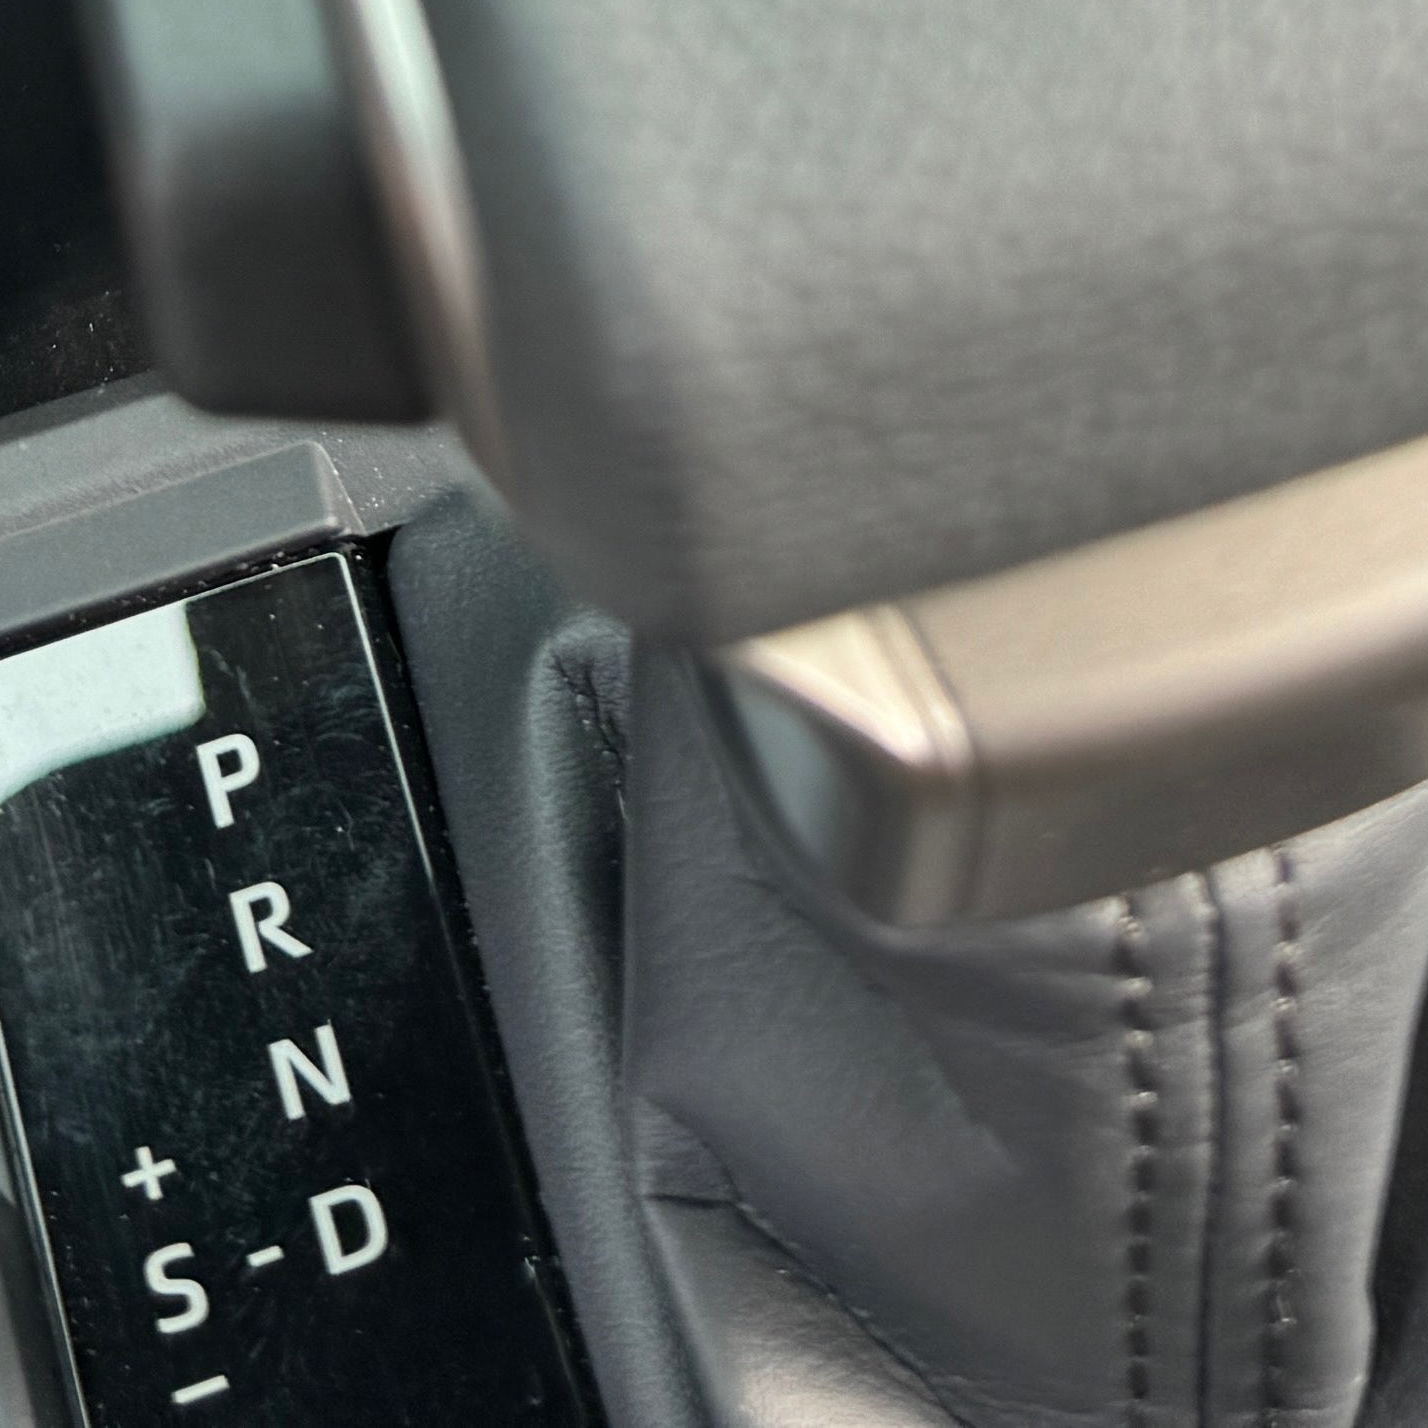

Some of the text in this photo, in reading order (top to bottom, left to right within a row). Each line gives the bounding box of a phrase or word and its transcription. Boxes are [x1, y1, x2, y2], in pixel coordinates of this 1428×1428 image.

[195, 733, 260, 828] P
[229, 881, 313, 973] R
[268, 1021, 351, 1120] N
[143, 1183, 388, 1334] S D
